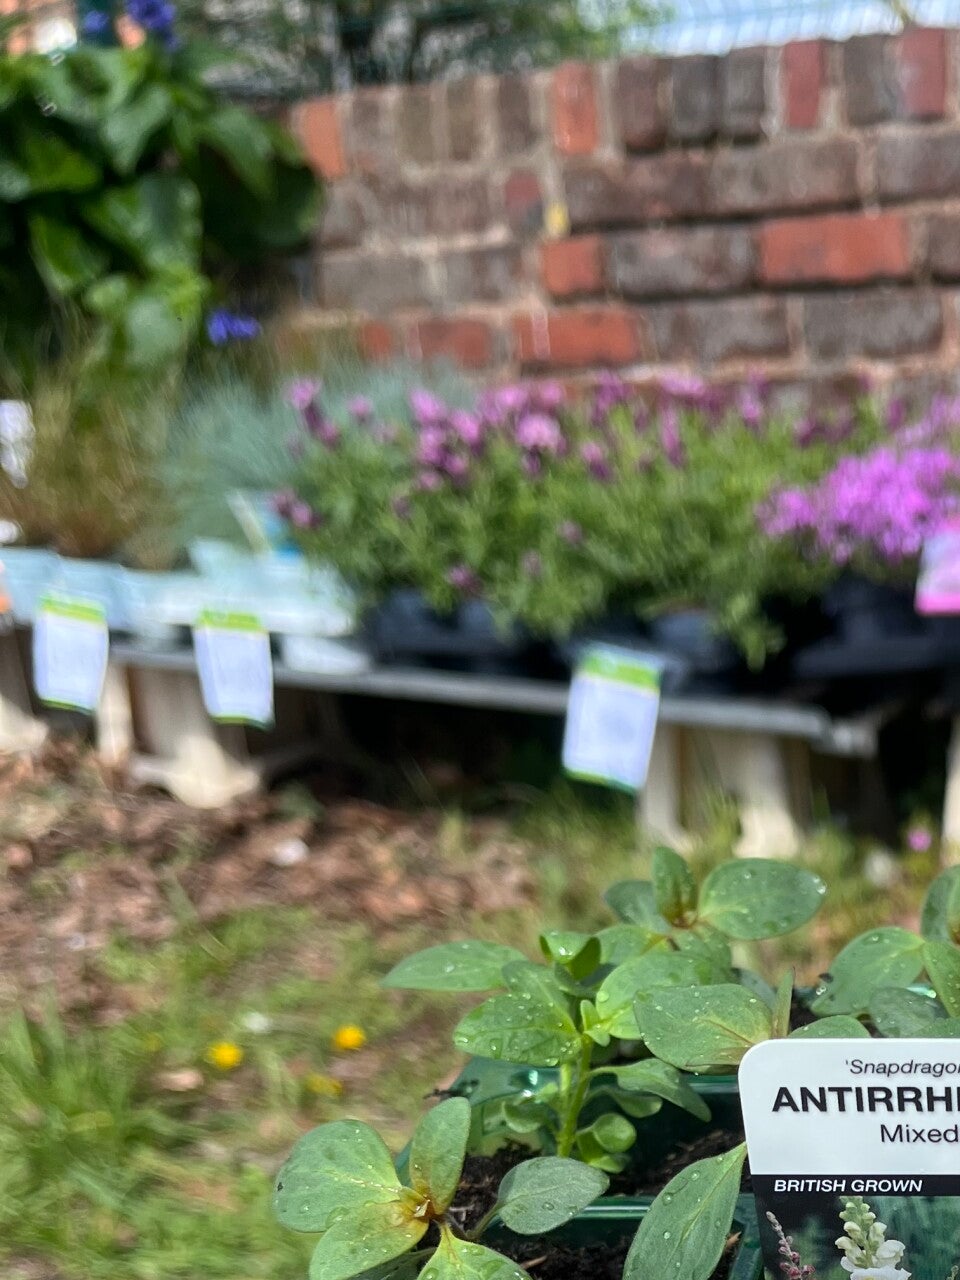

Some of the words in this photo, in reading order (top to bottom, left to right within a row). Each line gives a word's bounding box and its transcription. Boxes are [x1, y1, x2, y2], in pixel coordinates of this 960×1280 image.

[880, 1124, 959, 1143] Mixed
[774, 1179, 847, 1192] BRITISH
[851, 1179, 922, 1192] GROWN
